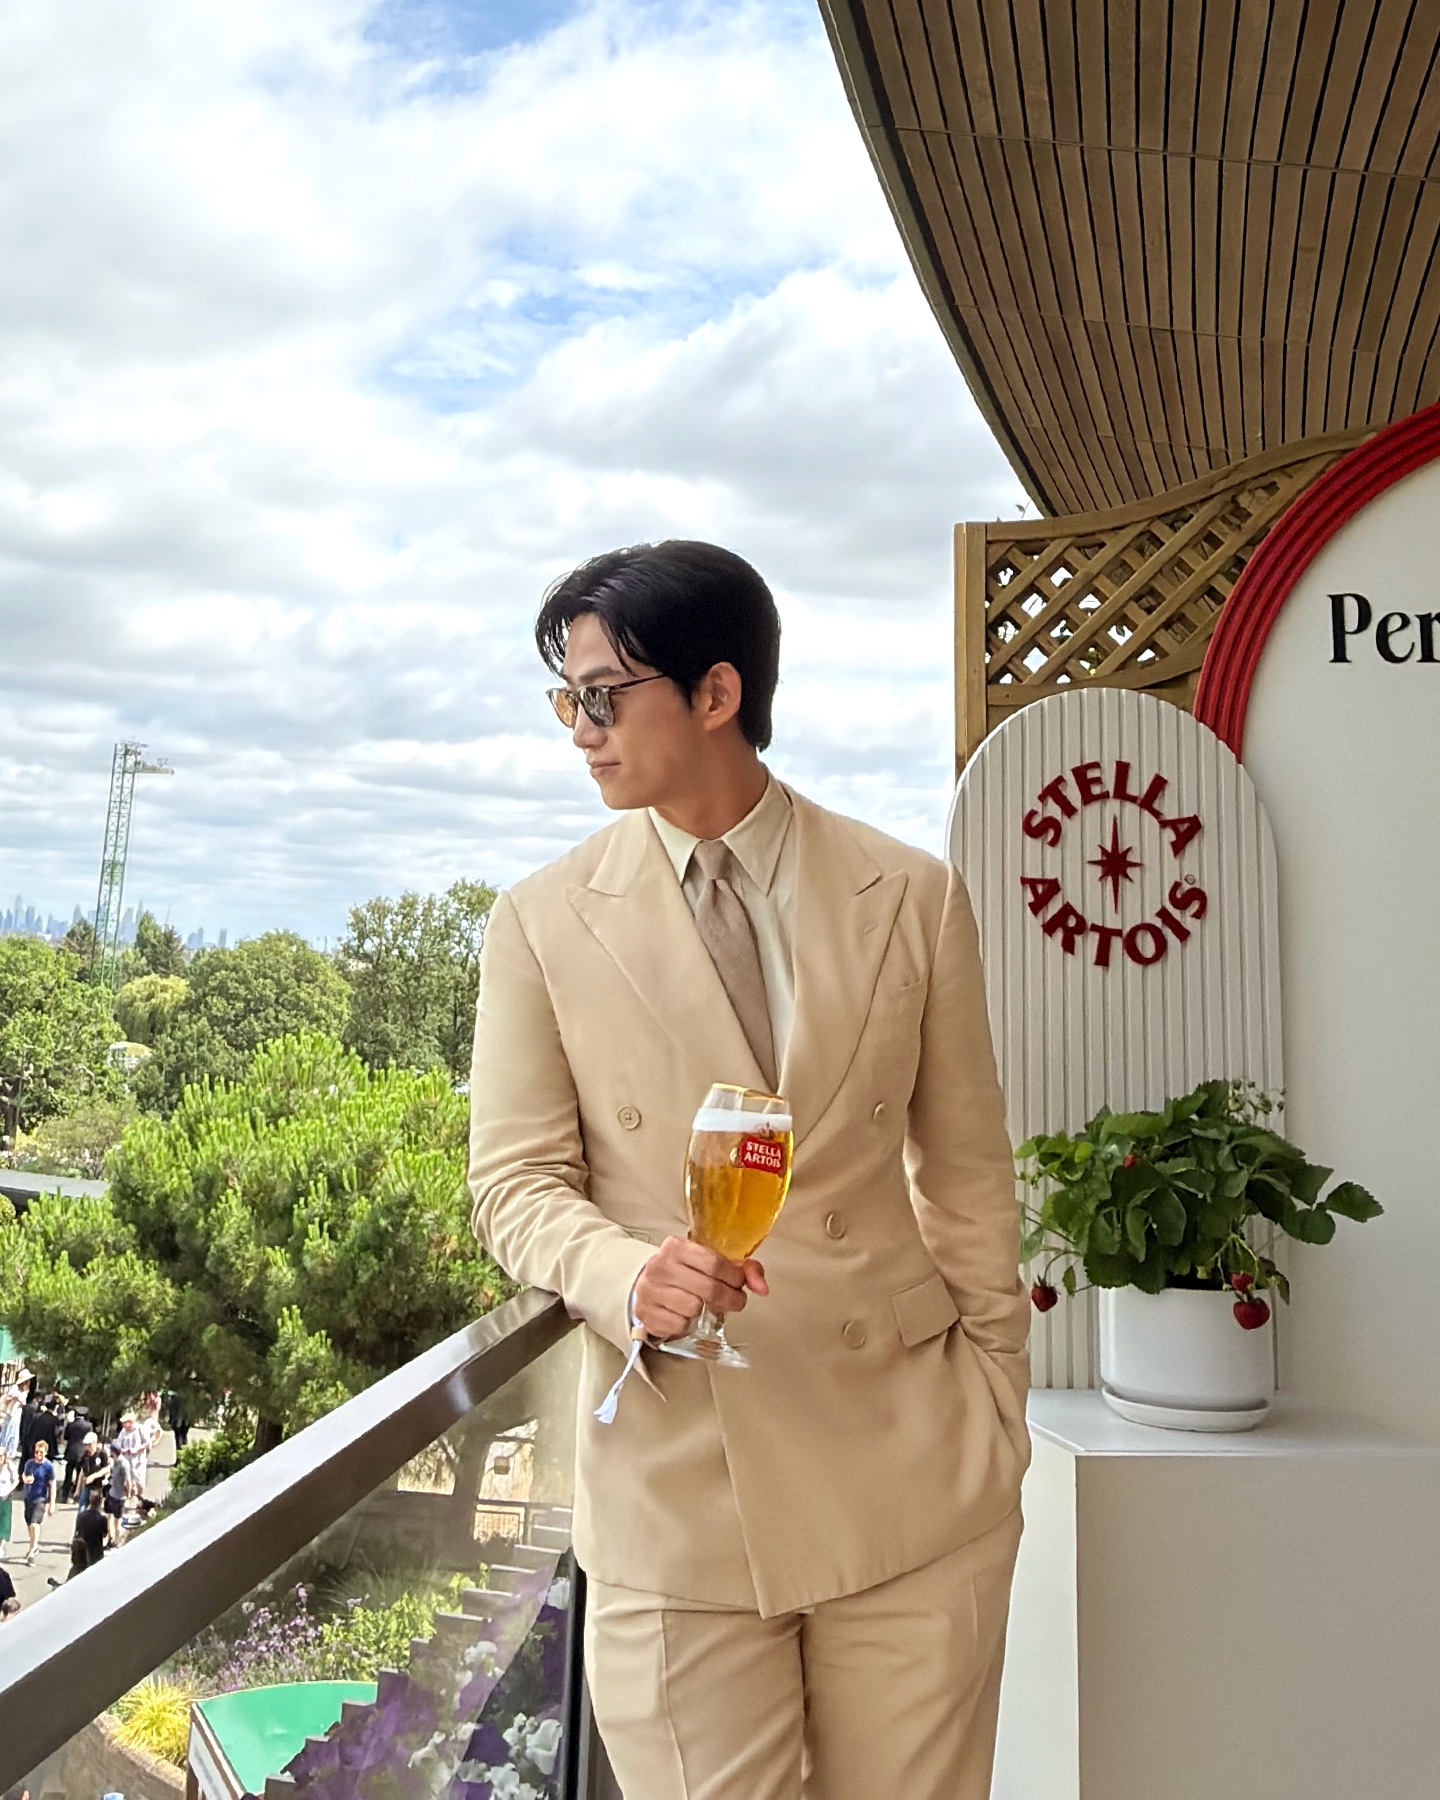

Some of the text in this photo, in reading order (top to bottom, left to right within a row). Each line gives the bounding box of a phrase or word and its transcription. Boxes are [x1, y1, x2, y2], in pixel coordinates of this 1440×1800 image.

[1327, 593, 1440, 663] Per
[1022, 760, 1202, 858] STELLA
[1020, 876, 1207, 967] ARTOIS
[744, 1151, 781, 1168] ARTOIS
[746, 1141, 782, 1160] STELLA
